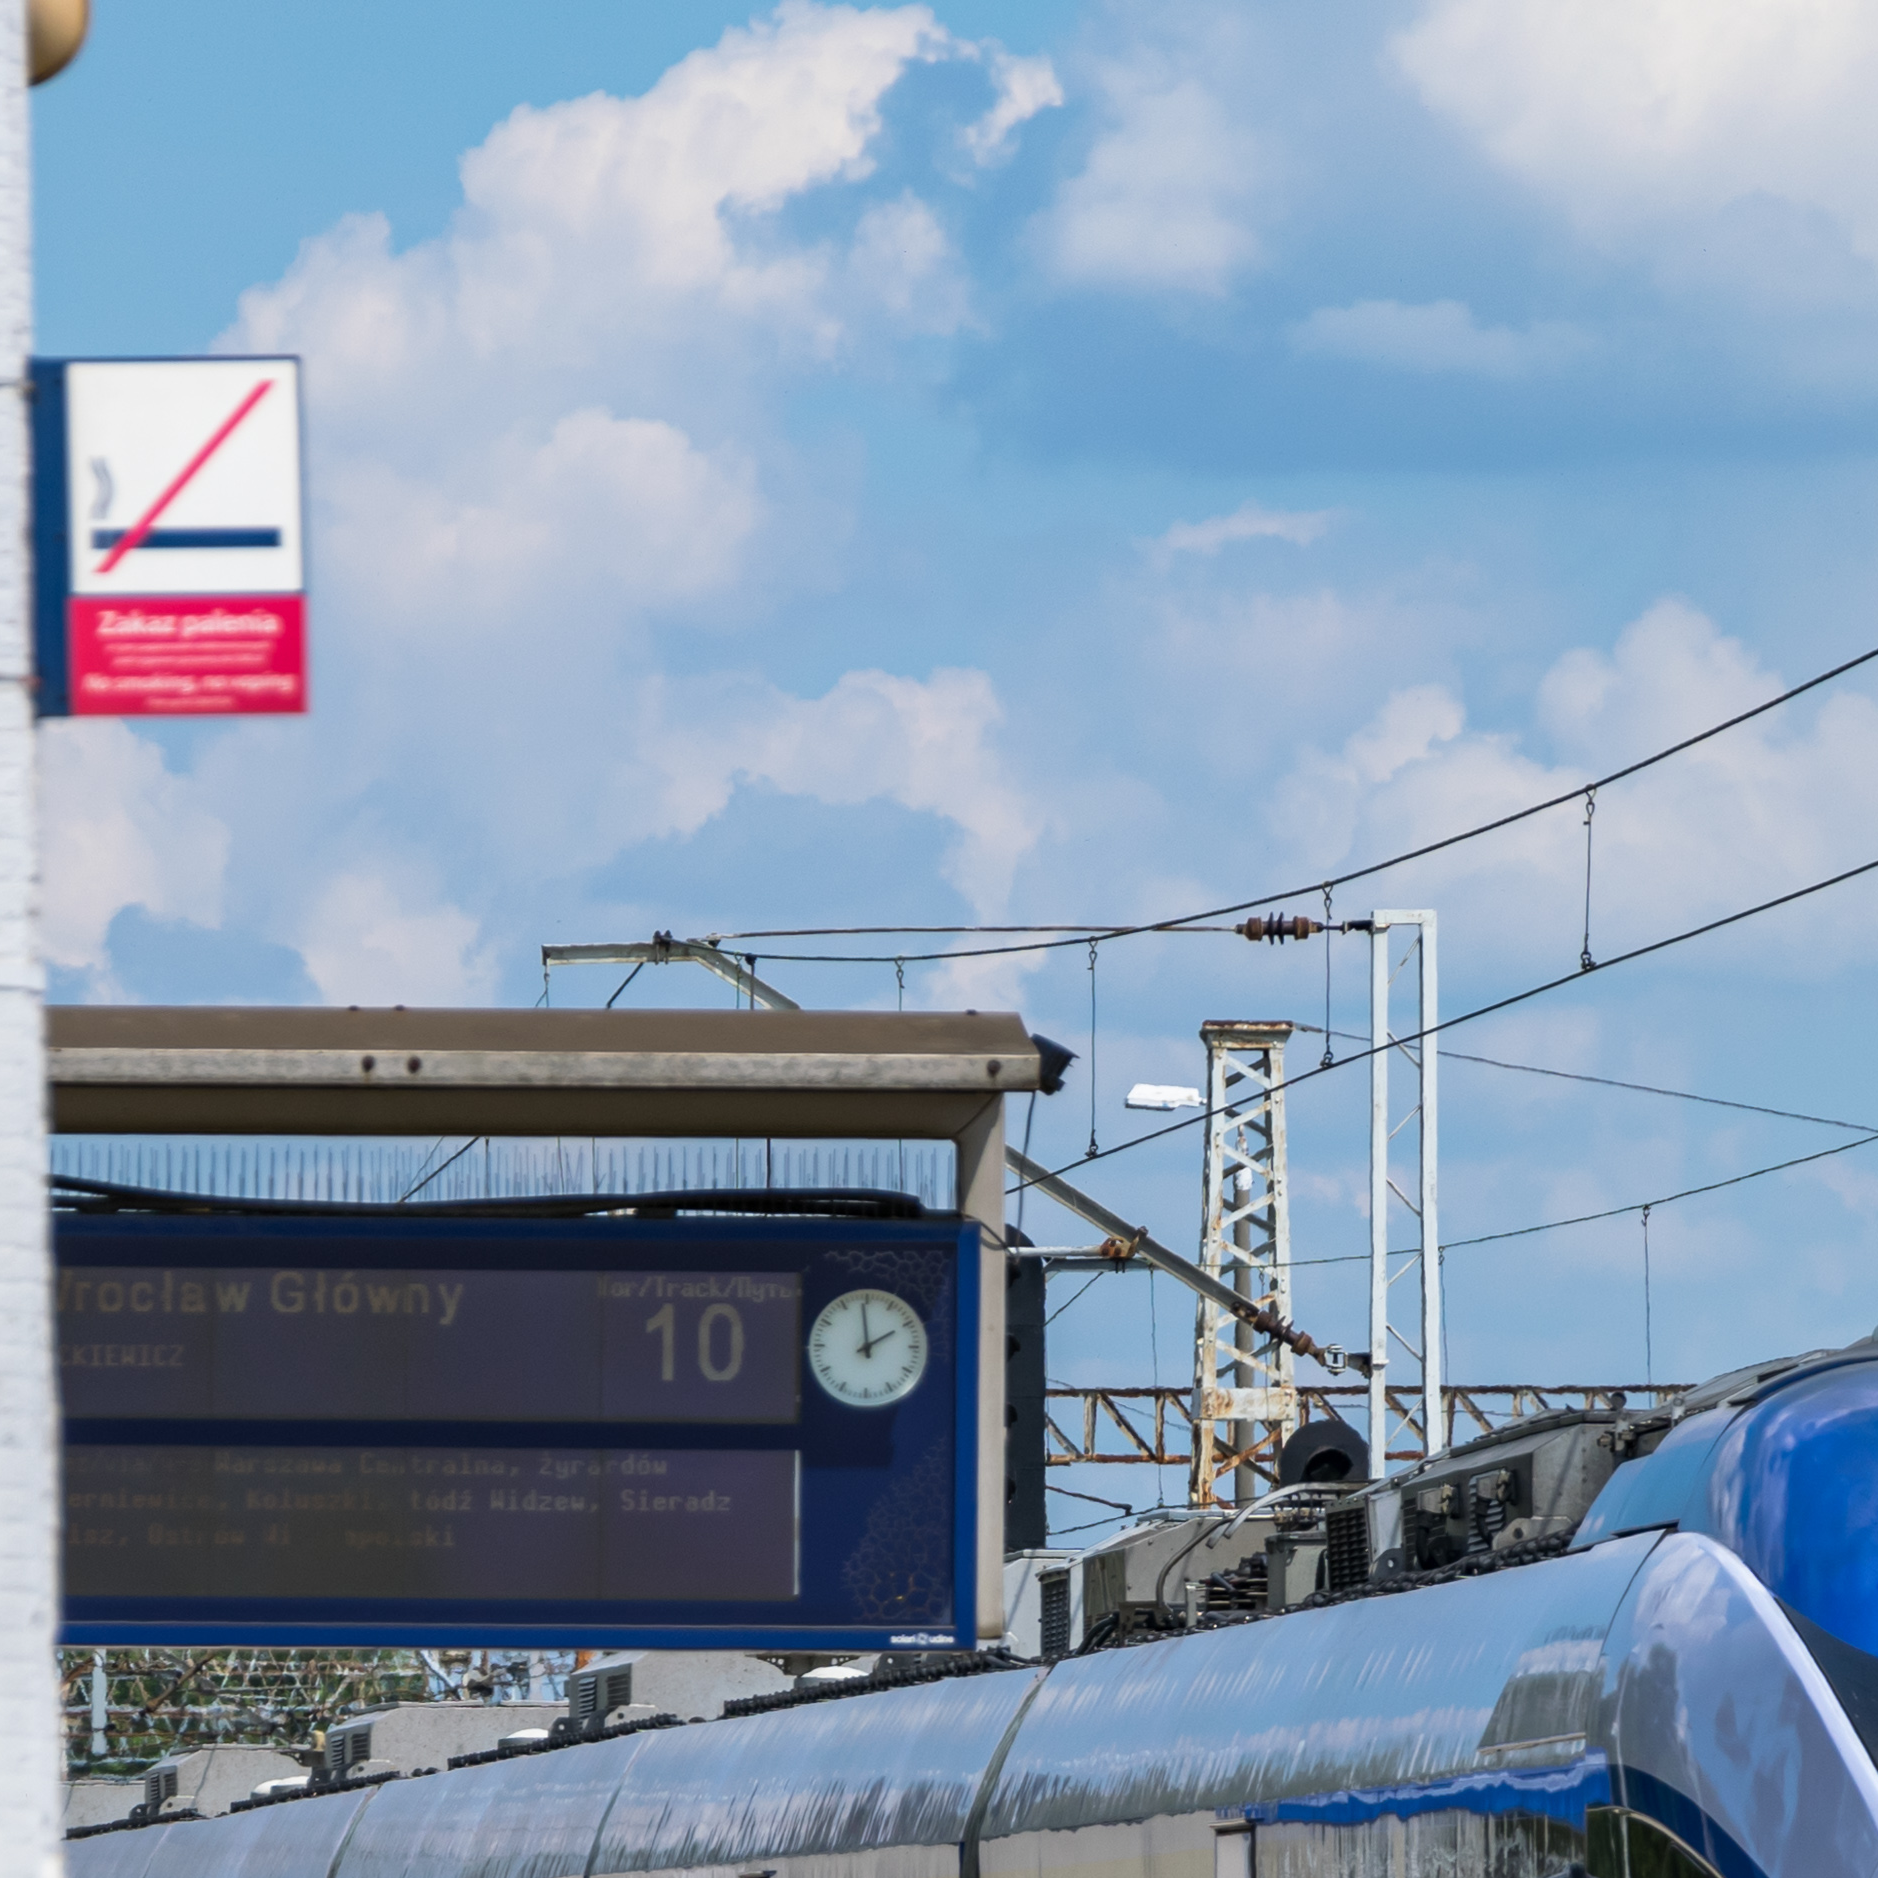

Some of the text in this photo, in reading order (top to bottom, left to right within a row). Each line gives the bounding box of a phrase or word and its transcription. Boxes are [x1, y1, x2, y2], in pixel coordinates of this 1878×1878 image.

[96, 609, 177, 637] Zakaz
[271, 1269, 464, 1326] Główny
[645, 1303, 745, 1382] 10
[409, 1489, 474, 1512] Łódź
[490, 1489, 601, 1514] Widzew,
[620, 1489, 732, 1512] Sieradz
